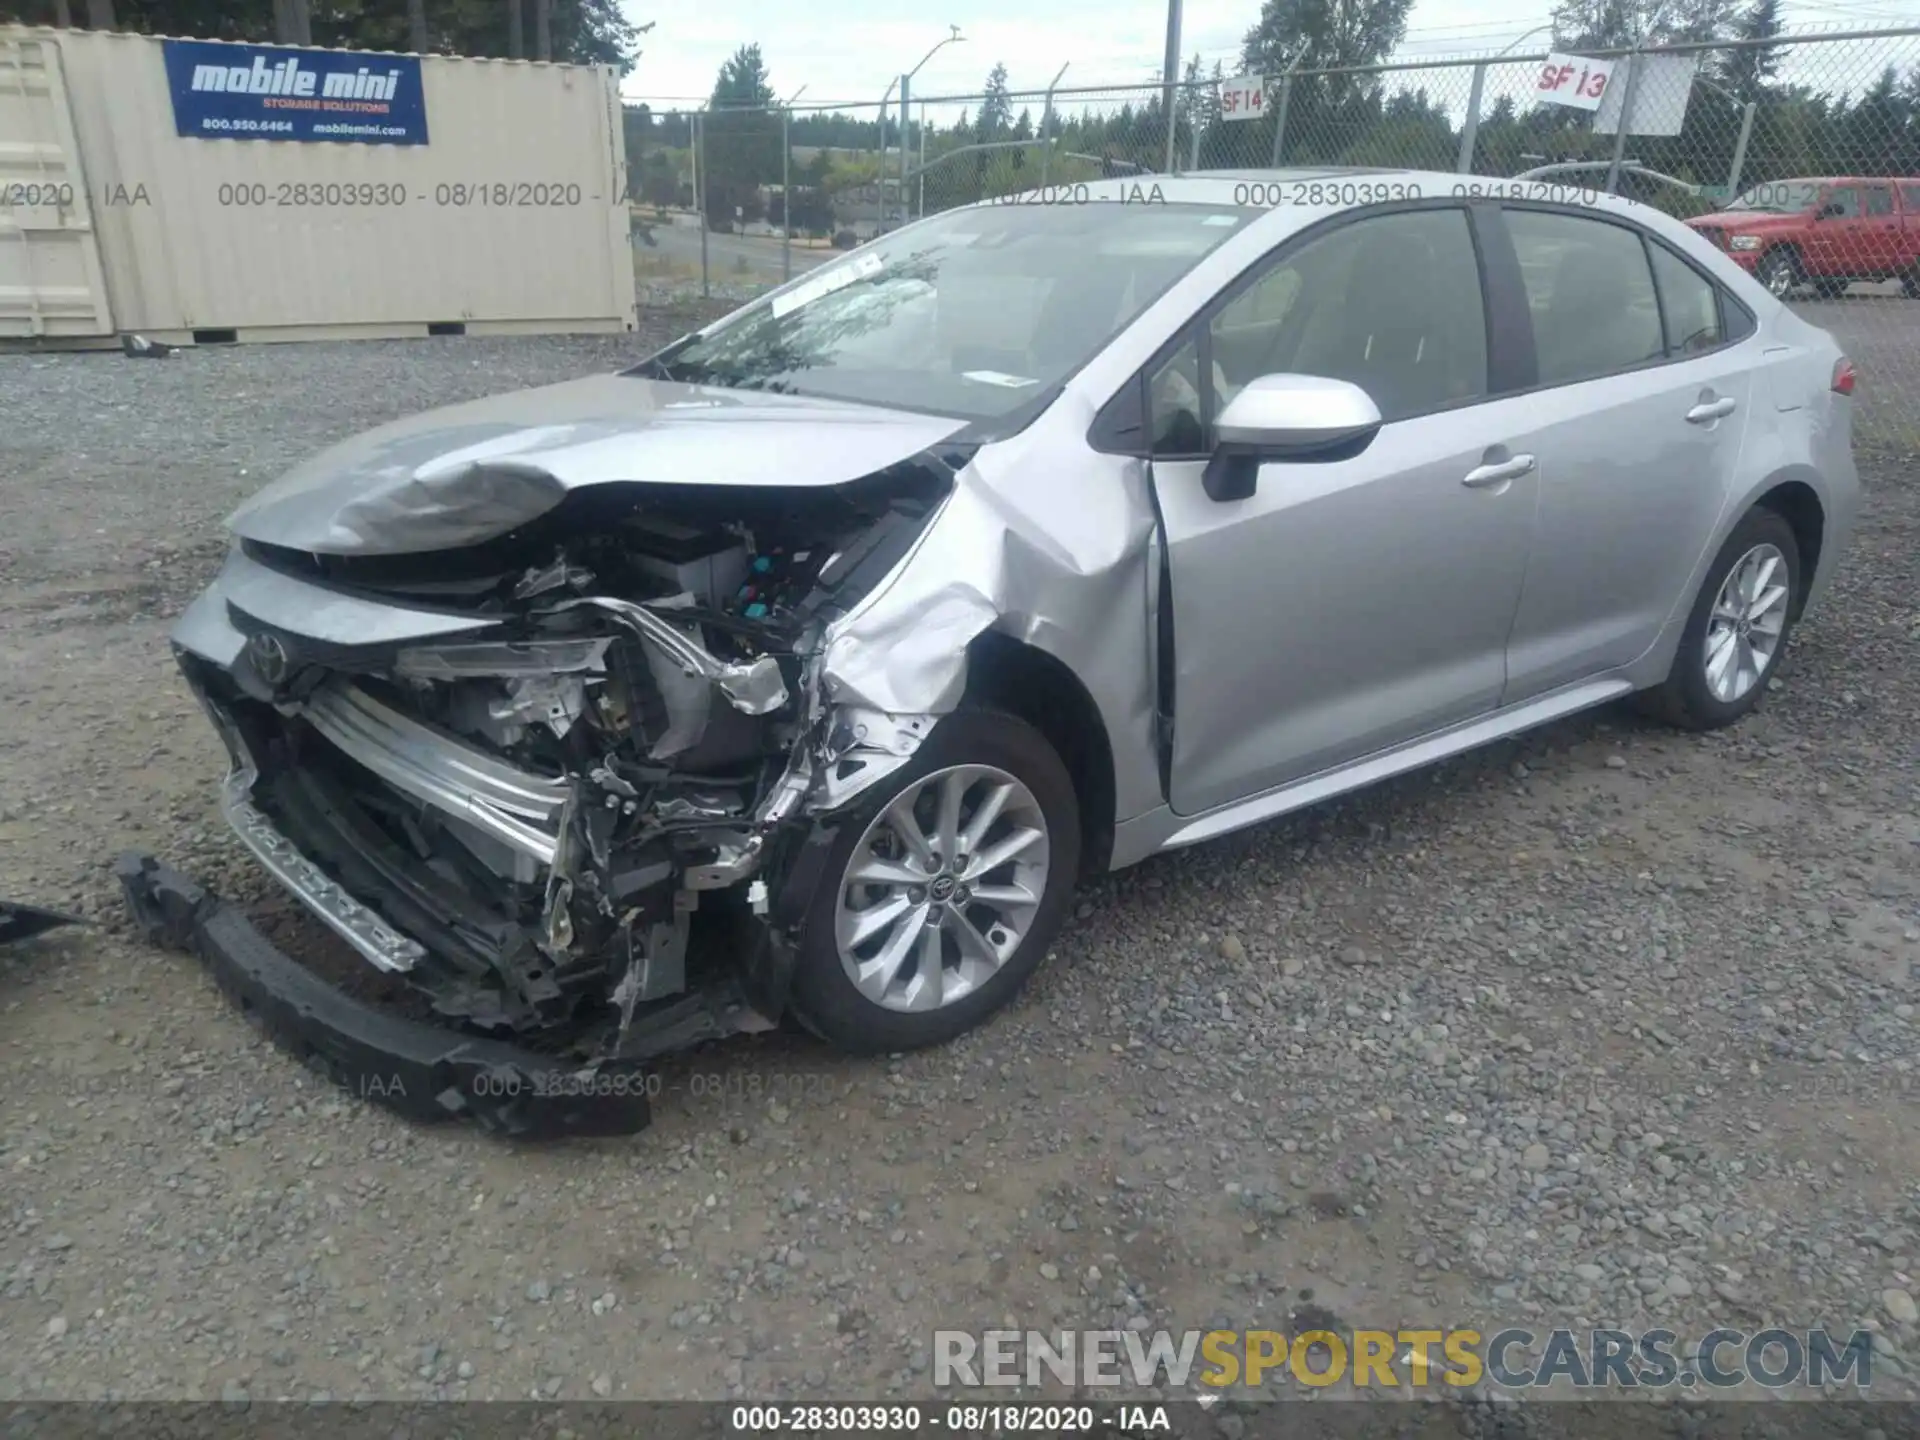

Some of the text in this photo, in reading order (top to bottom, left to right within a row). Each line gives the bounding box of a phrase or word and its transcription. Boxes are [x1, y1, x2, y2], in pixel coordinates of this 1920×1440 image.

[192, 56, 400, 100] mobile mini
[313, 122, 406, 136] mobilemini.com
